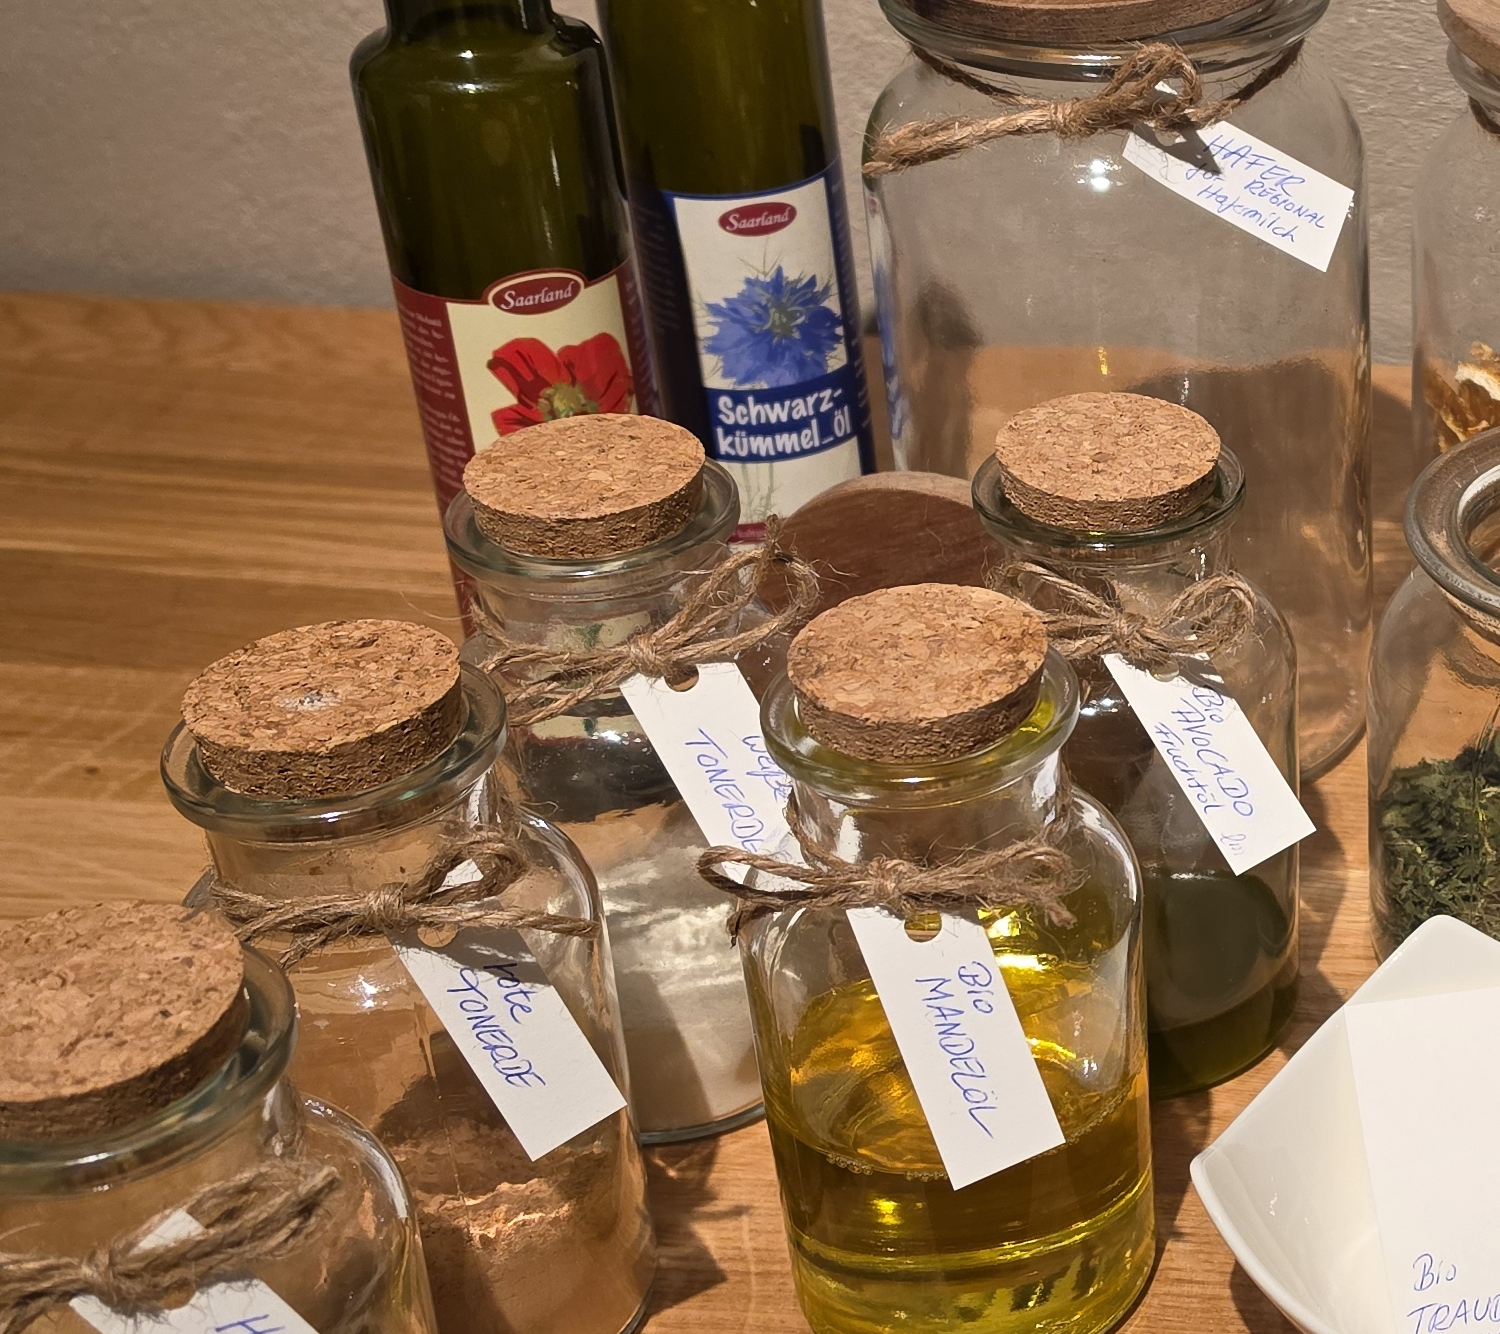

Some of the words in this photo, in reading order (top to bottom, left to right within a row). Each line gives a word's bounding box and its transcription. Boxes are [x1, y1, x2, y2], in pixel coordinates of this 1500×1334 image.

[1203, 134, 1306, 197] HAFER
[725, 207, 791, 233] Saarland
[1244, 178, 1325, 229] REGIONAL
[500, 281, 574, 310] Saarland
[718, 388, 843, 426] Schwarz-
[1192, 684, 1225, 724] Bio
[1171, 697, 1254, 817] AVOCADO
[957, 960, 995, 1015] Bio
[446, 967, 546, 1088] TONERDE
[915, 977, 998, 1140] MANDELÖL
[1412, 1252, 1457, 1292] Bio
